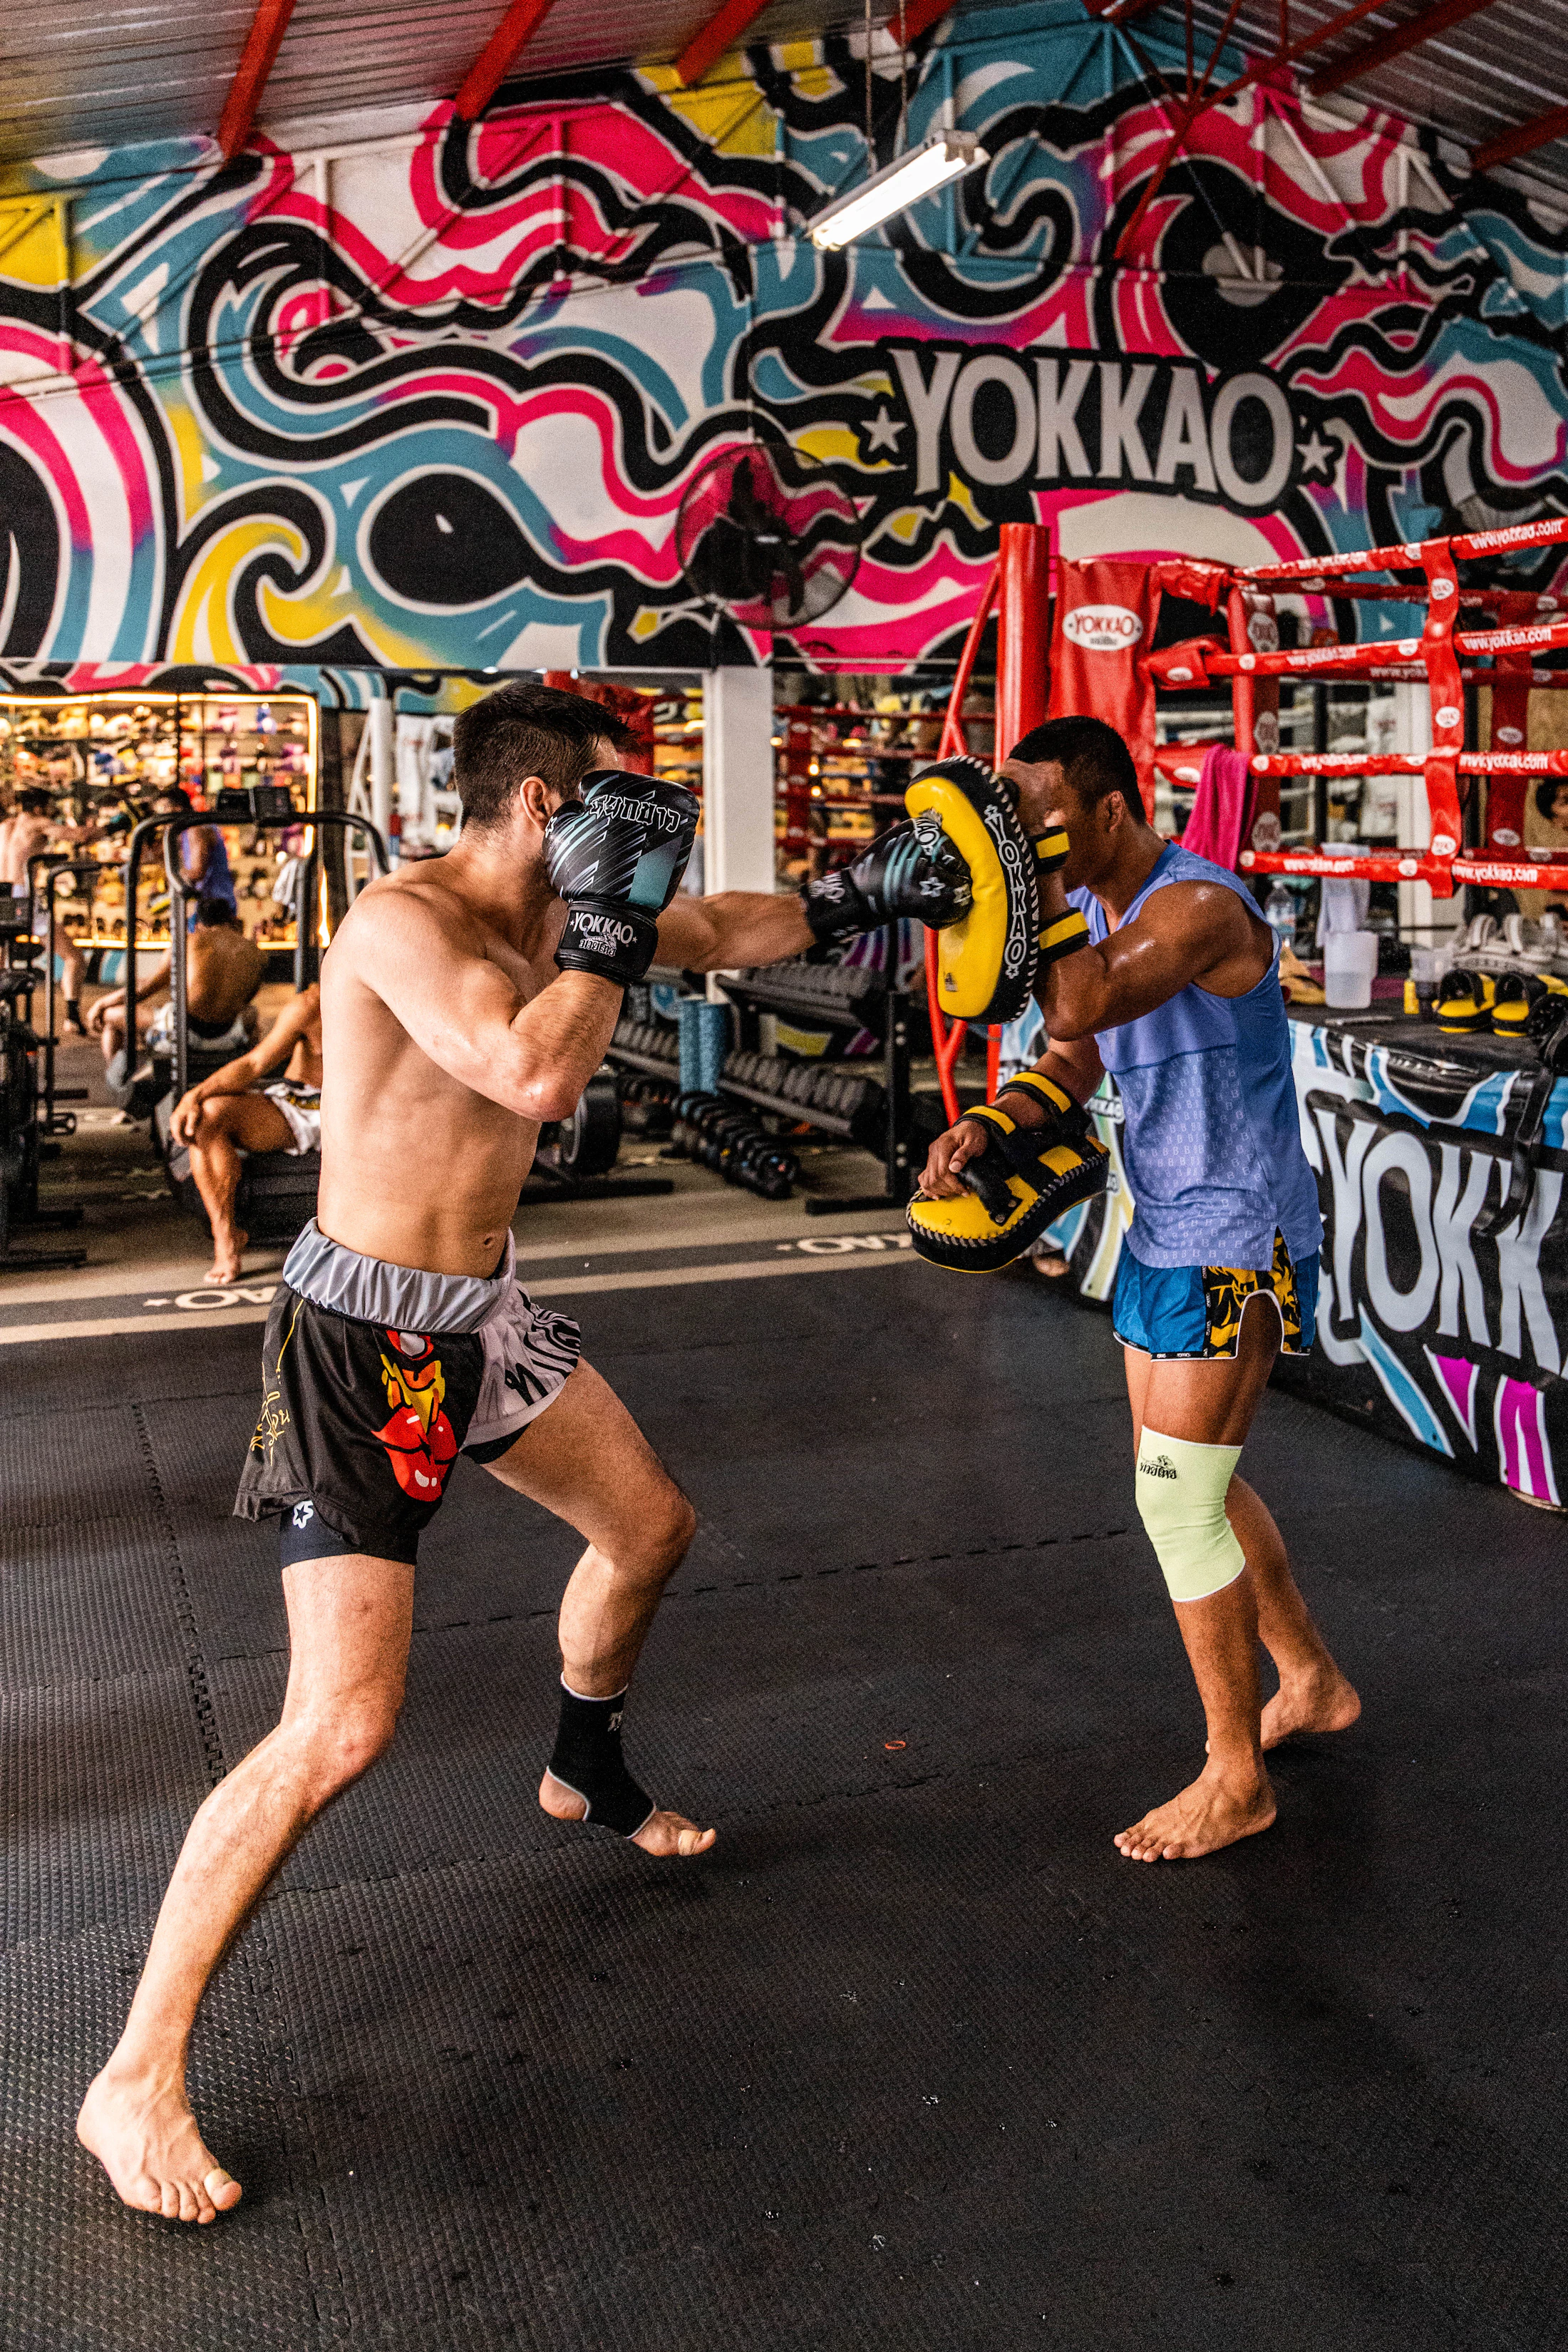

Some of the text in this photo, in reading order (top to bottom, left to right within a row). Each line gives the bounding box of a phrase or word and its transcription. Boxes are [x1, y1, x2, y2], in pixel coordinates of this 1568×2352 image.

[889, 349, 1294, 508] YOKKAO
[572, 912, 634, 944] YOKKAO
[984, 813, 1028, 966] YOKKAO
[1313, 1109, 1568, 1379] YOKK
